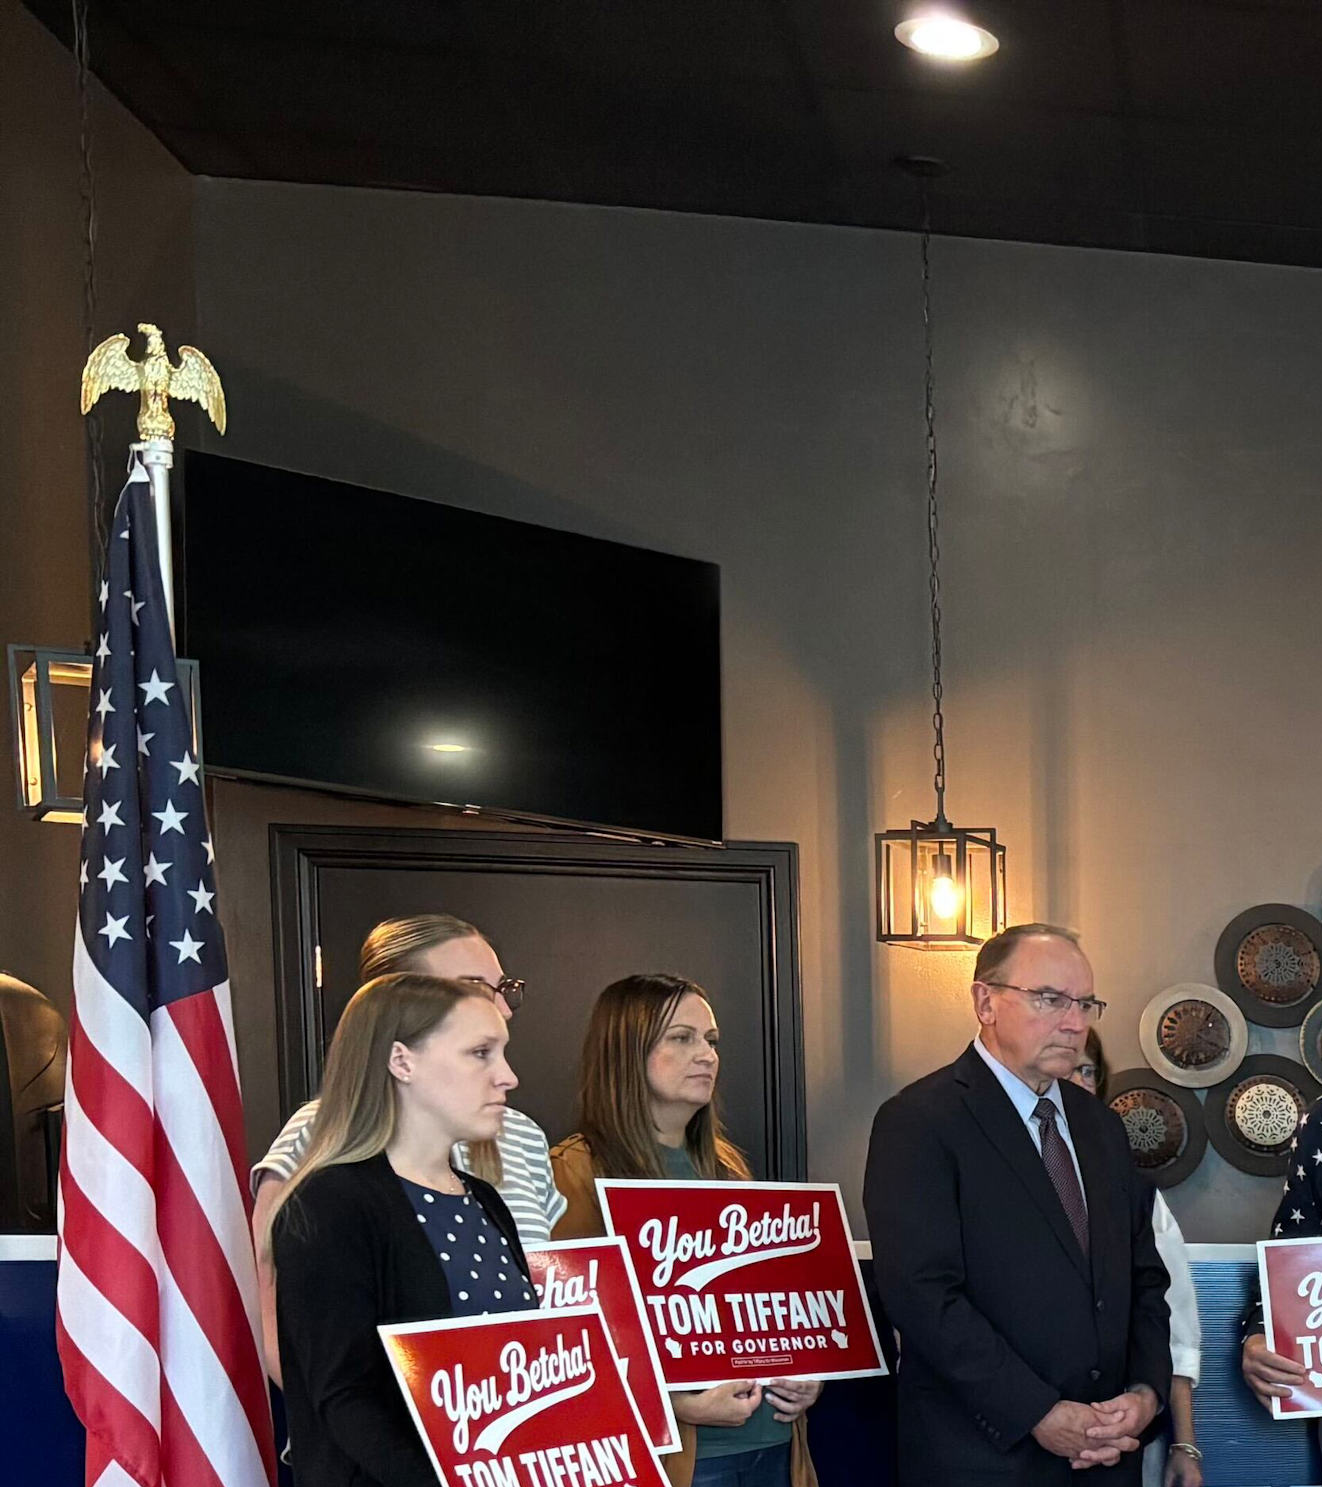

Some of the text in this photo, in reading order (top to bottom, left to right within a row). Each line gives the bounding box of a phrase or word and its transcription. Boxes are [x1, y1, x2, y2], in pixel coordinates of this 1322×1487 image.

[639, 1216, 716, 1288] You
[719, 1202, 820, 1255] Betcha!
[647, 1290, 846, 1335] TOM TIFFANY
[690, 1335, 828, 1356] FOR GOVERNOR
[431, 1329, 591, 1454] You Betcha!
